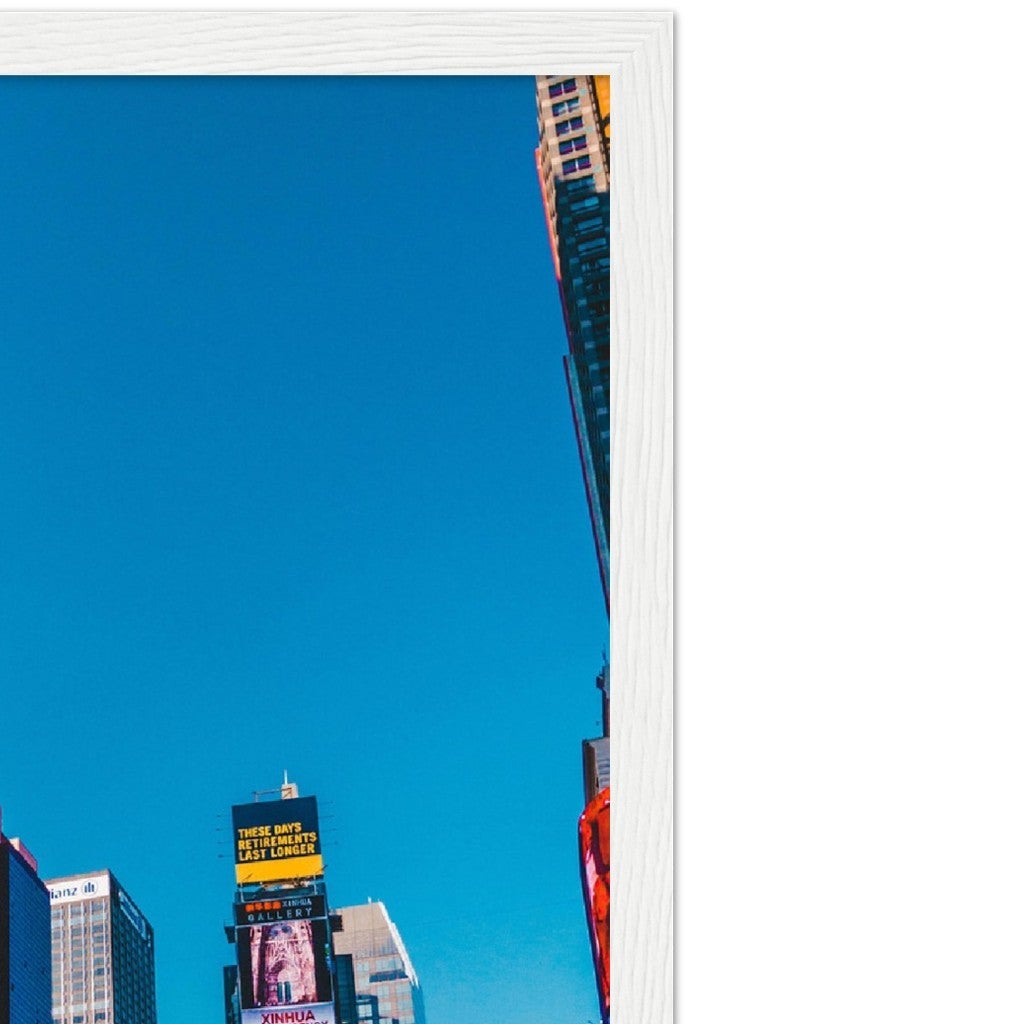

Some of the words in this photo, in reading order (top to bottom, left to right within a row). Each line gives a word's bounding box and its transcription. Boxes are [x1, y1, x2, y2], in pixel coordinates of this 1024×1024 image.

[238, 825, 271, 839] THESE
[274, 822, 301, 835] DAYS
[238, 832, 317, 851] RETIREMENTS
[238, 848, 267, 861] LAST
[270, 843, 315, 858] LONGER
[261, 1010, 316, 1024] XINHUA
